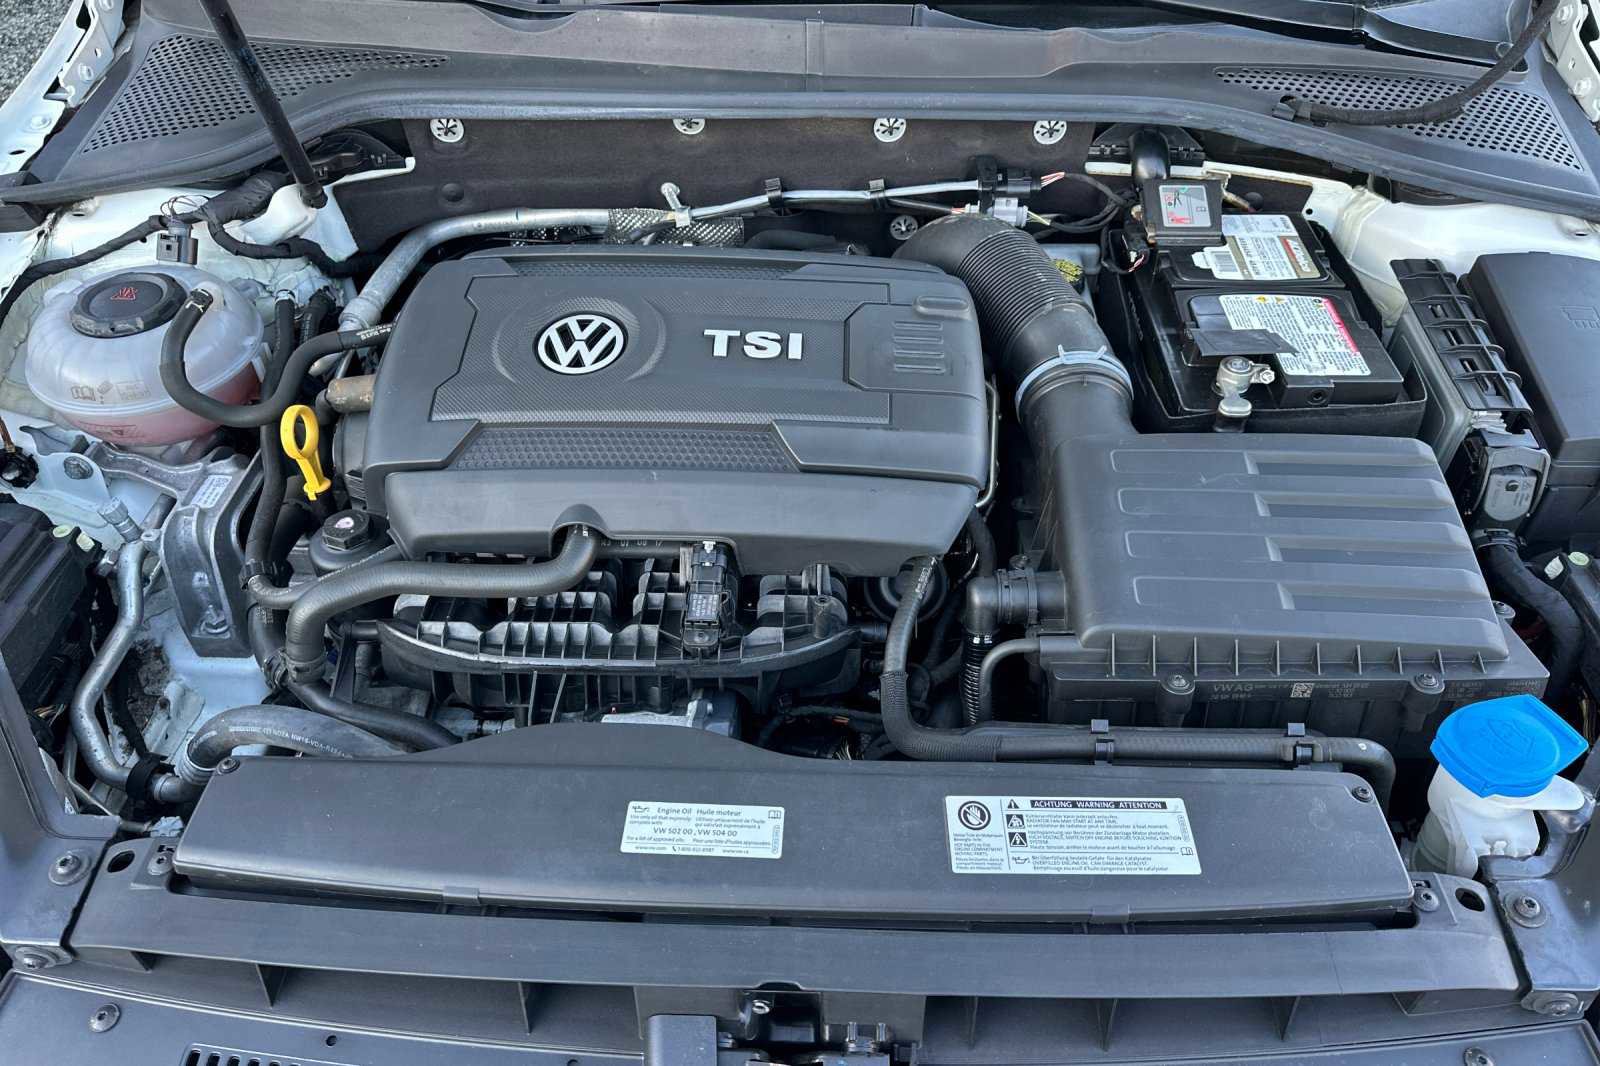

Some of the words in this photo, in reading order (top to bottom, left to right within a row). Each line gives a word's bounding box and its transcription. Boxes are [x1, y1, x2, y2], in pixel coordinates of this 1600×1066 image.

[537, 313, 625, 375] VW
[704, 329, 803, 360] TSI
[657, 807, 680, 815] Engine
[682, 808, 692, 816] Oil
[696, 808, 714, 816] Huile
[653, 826, 667, 834] VW
[668, 827, 681, 835] 502
